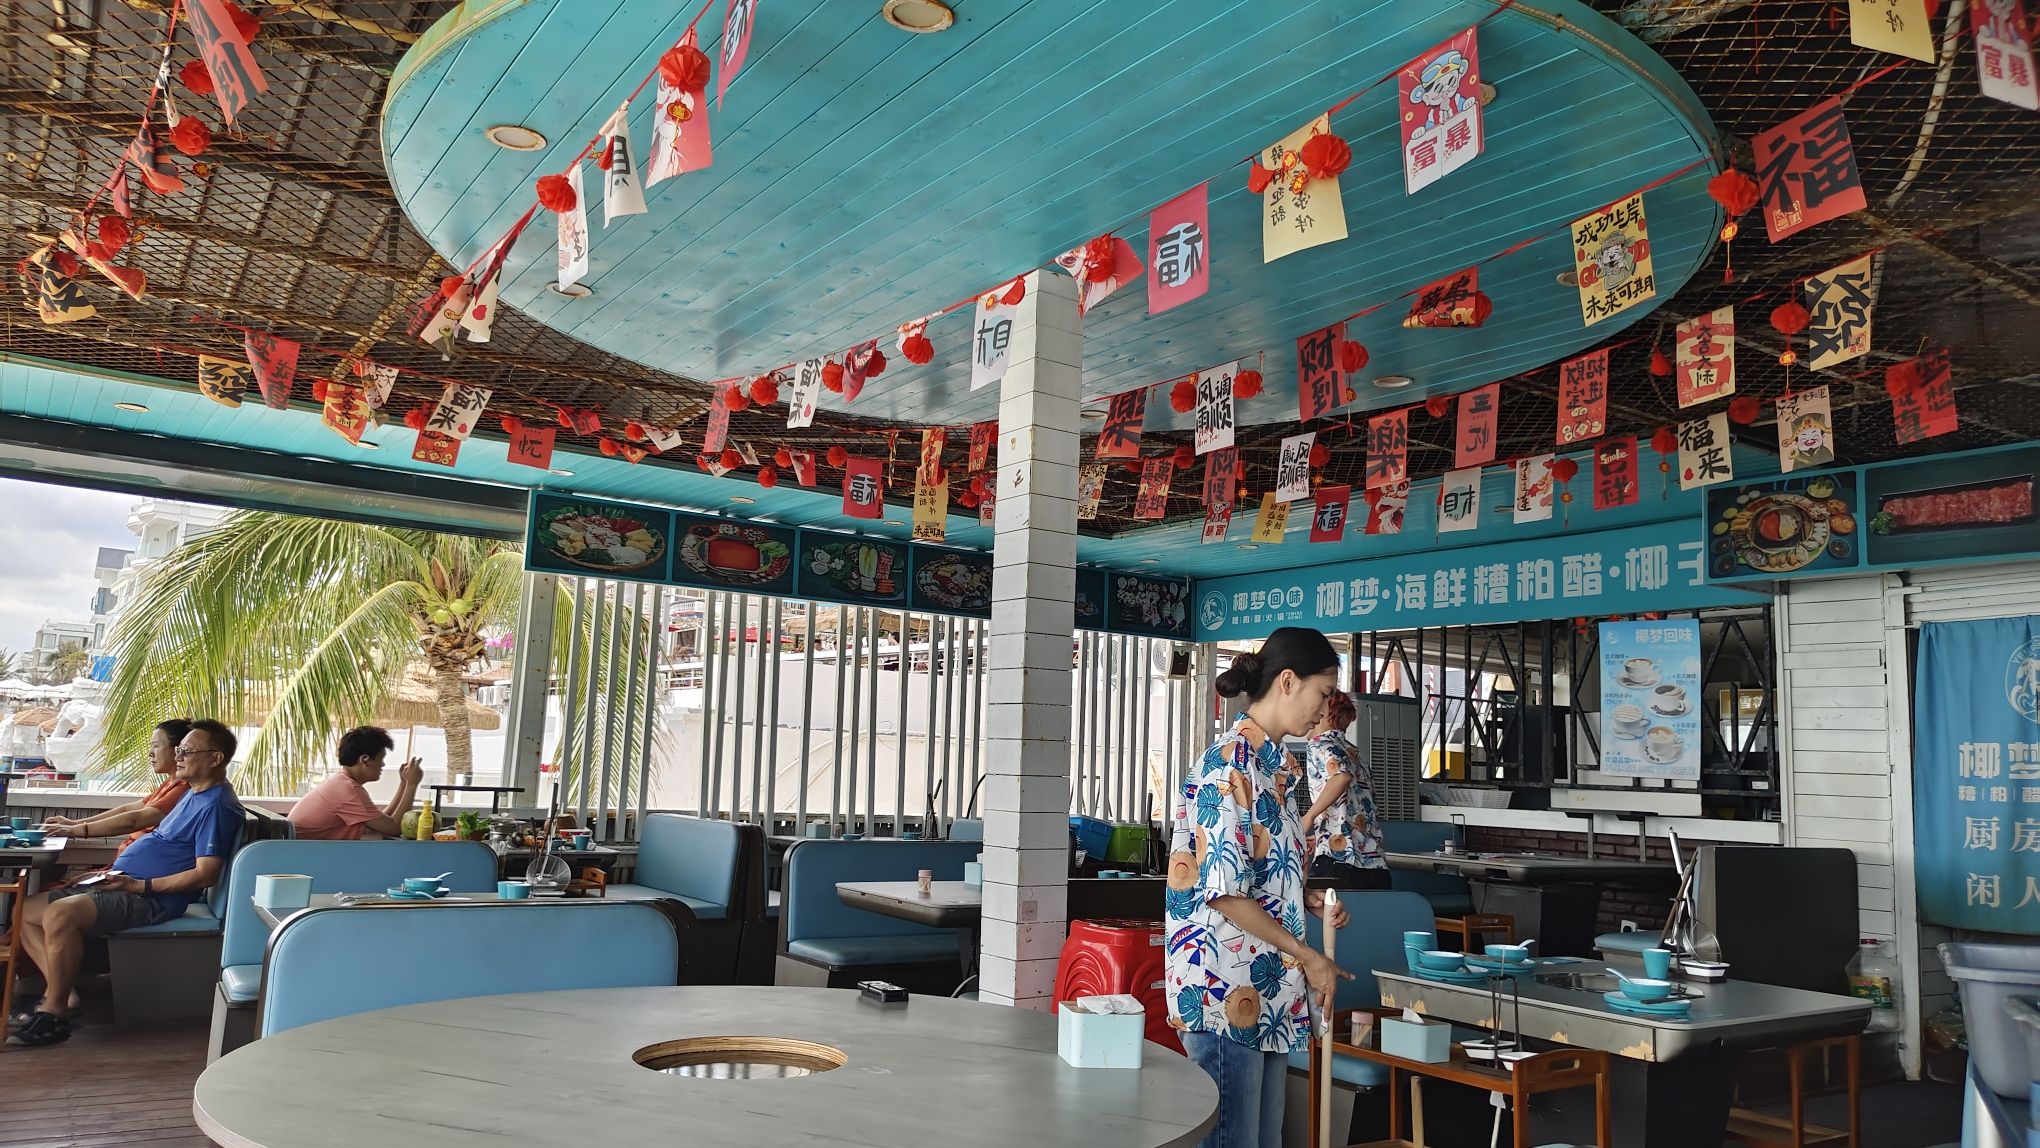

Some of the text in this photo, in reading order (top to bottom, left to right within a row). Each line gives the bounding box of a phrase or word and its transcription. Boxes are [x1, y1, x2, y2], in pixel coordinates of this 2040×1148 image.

[1760, 105, 1858, 211] 福
[1577, 197, 1642, 246] 成功上岸
[1585, 276, 1654, 320] 未来可期
[1680, 422, 1730, 479] 福来
[1317, 503, 1343, 530] 福
[1443, 485, 1476, 519] 財
[1232, 586, 1304, 611] 椰梦回味
[1635, 628, 1694, 643] 椰梦回味
[1958, 742, 2040, 779] 椰梦
[1963, 816, 2040, 852] 厨房
[1966, 873, 2040, 909] 闲人
